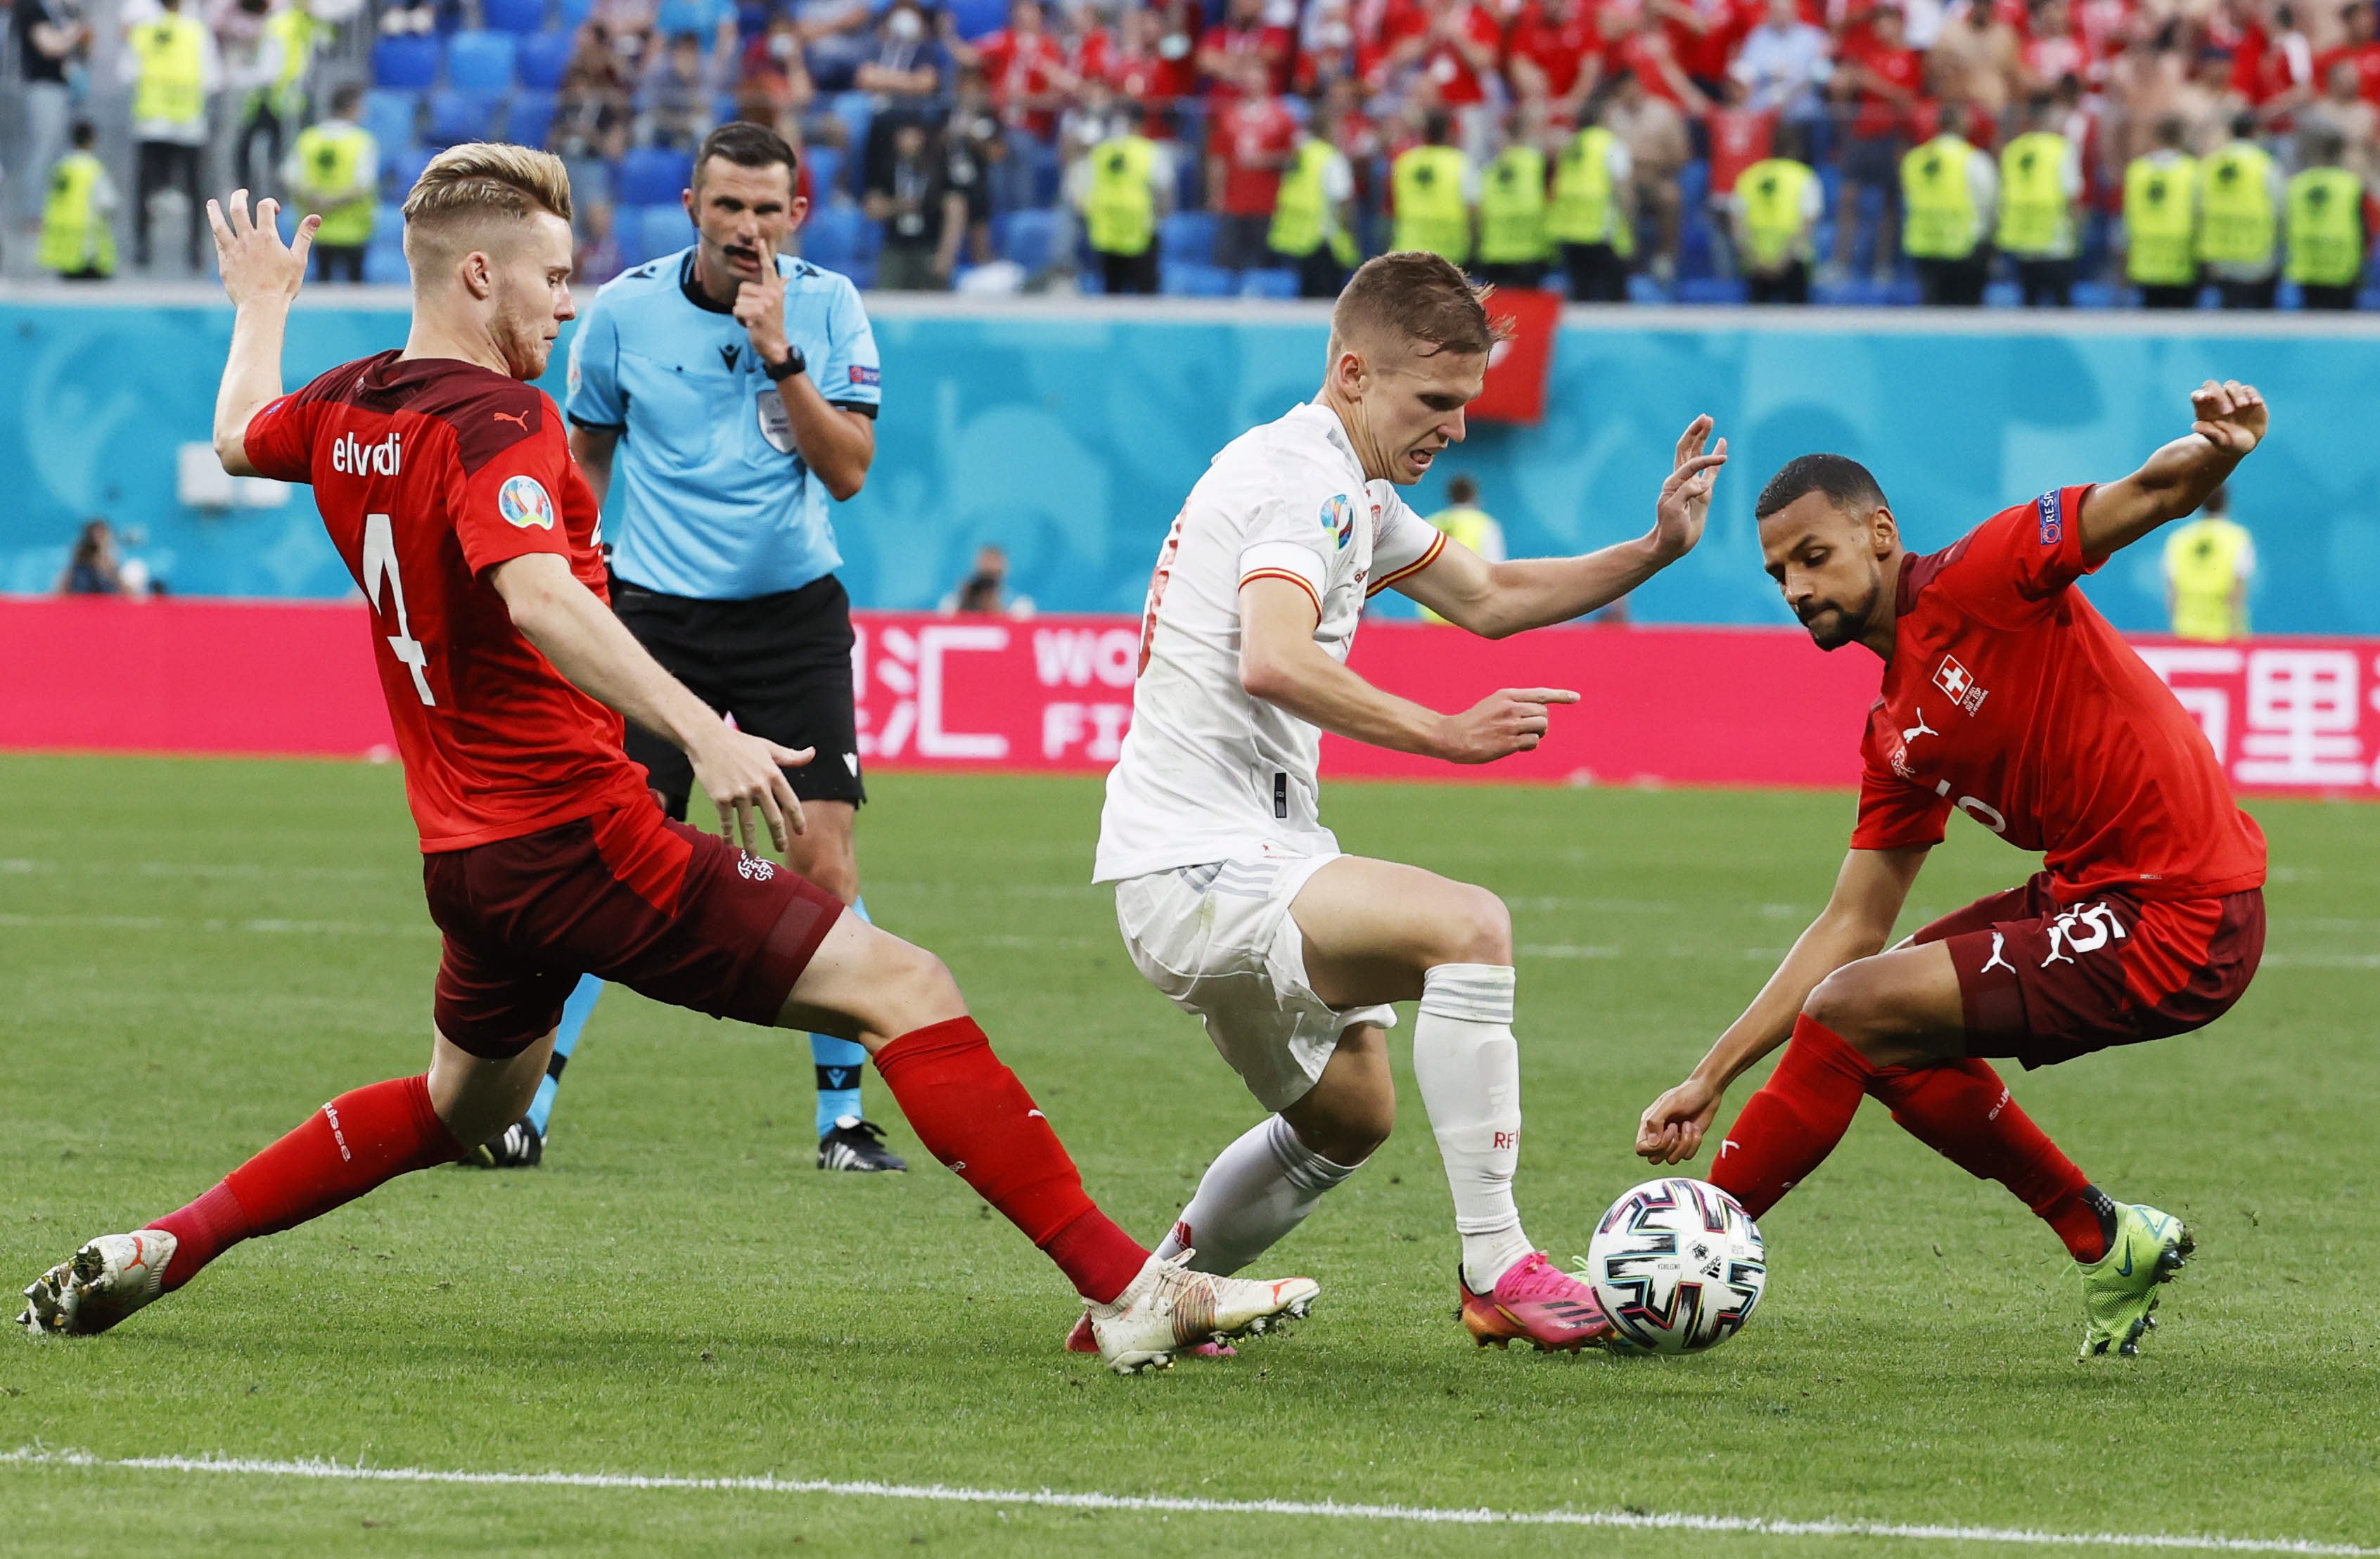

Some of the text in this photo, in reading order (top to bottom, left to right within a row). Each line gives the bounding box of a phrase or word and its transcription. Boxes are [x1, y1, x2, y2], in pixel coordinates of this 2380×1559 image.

[2043, 489, 2055, 522] RESP
[363, 514, 436, 706] 4
[850, 624, 1011, 759] 汇
